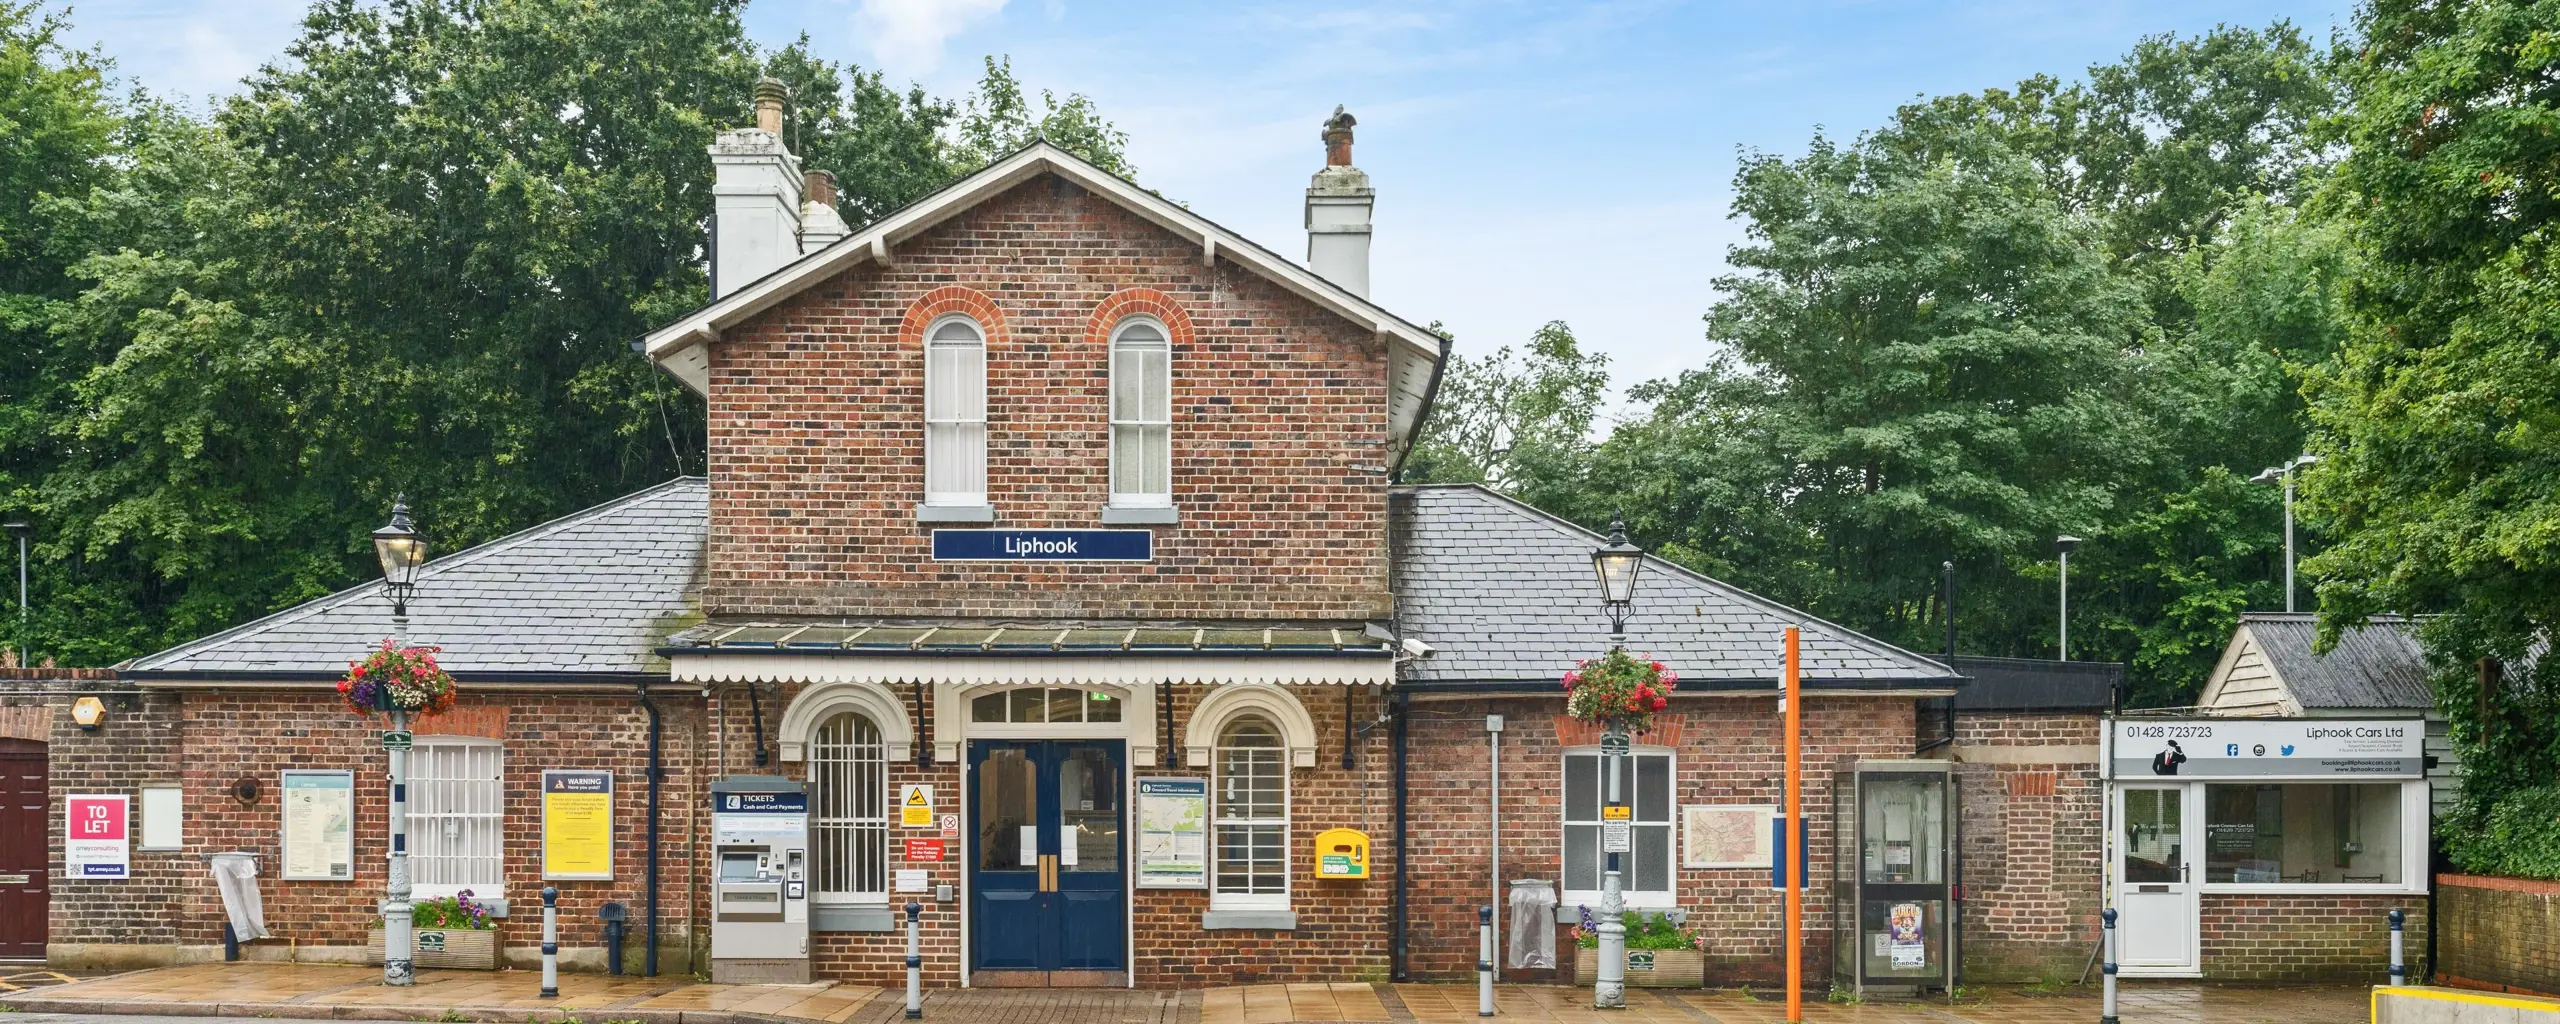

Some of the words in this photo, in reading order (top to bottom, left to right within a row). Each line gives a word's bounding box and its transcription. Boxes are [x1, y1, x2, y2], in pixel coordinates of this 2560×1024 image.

[1006, 536, 1078, 556] Liphook
[2127, 726, 2164, 738] 01428
[2168, 726, 2212, 738] 723723
[2306, 727, 2352, 740] Liphook
[2355, 727, 2382, 738] Cars
[2385, 727, 2403, 738] Ltd
[87, 806, 107, 819] TO
[84, 820, 111, 833] LET
[1893, 904, 1920, 917] CIRCUS
